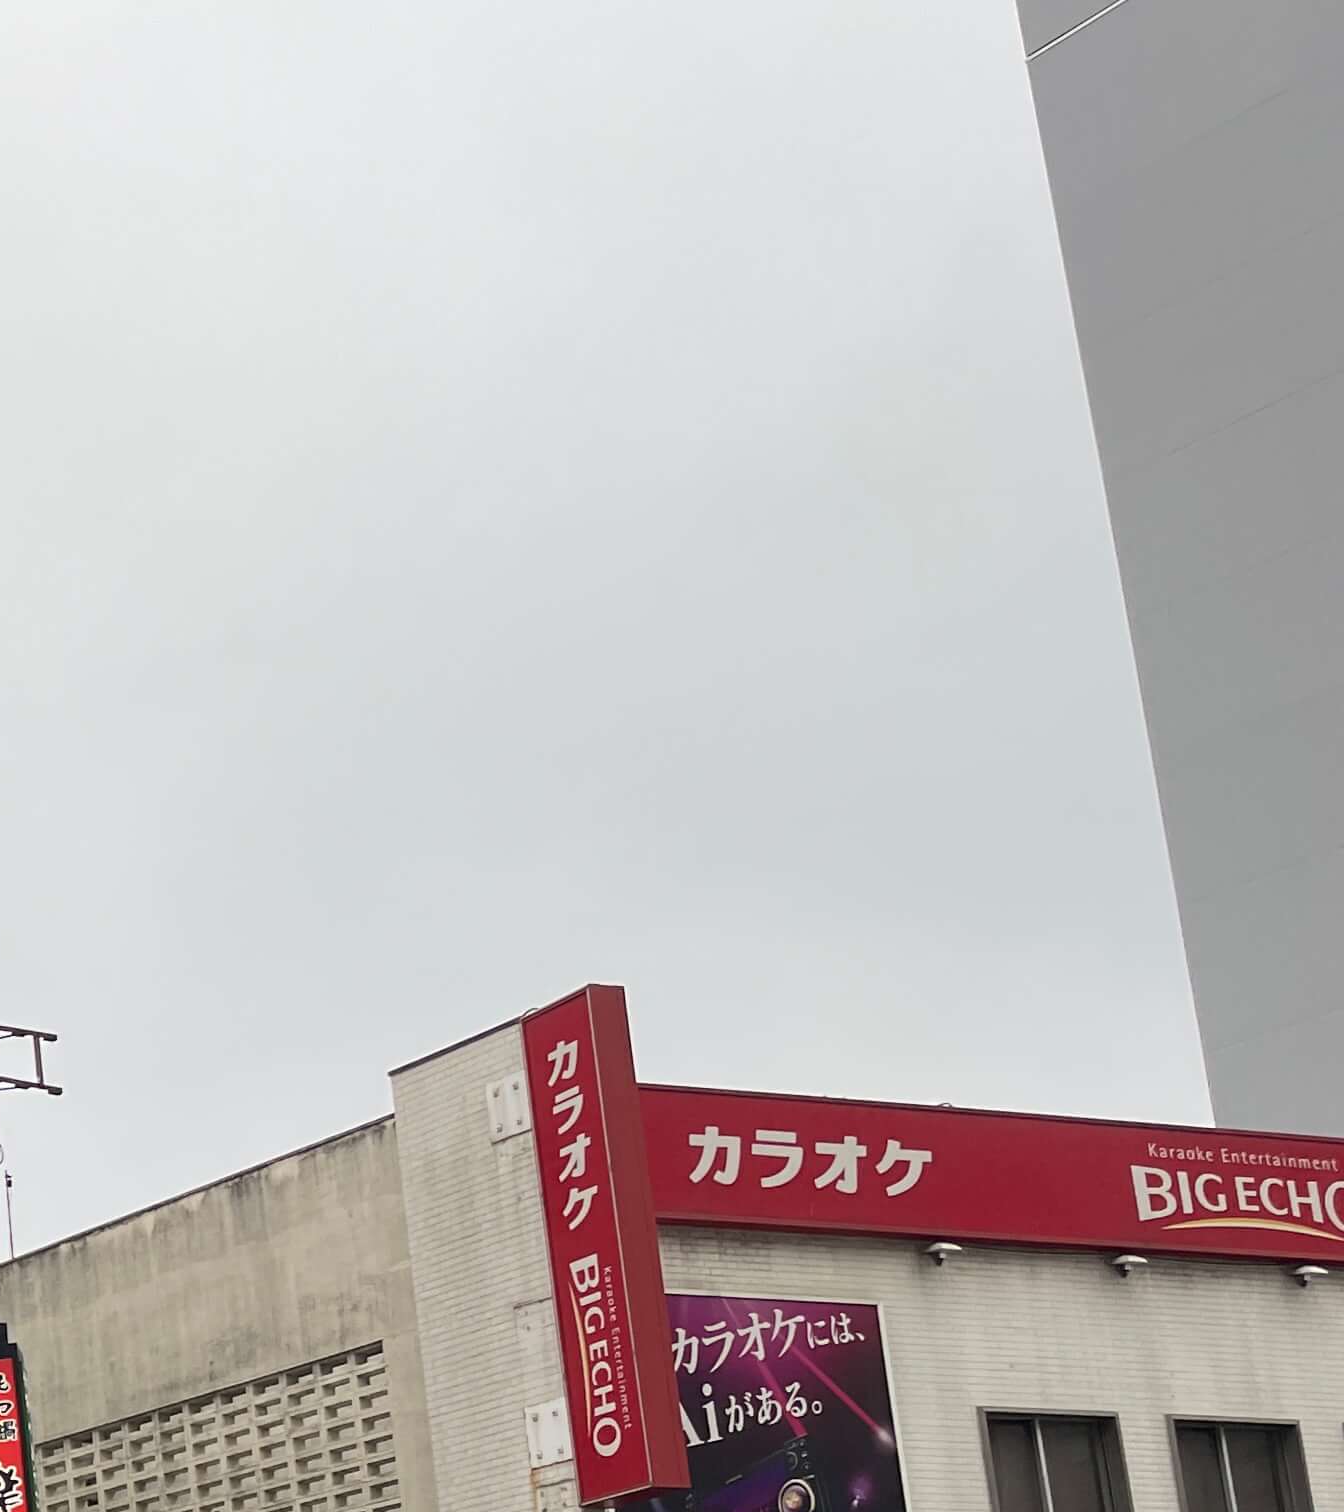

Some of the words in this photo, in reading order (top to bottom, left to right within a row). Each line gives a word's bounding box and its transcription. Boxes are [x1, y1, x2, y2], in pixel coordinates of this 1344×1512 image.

[547, 1040, 599, 1231] カラオケ
[688, 1126, 933, 1197] カラオケ
[1146, 1142, 1214, 1163] Karaoke
[1220, 1147, 1339, 1172] Entertainment
[1130, 1164, 1228, 1222] BIG
[568, 1253, 605, 1335] BIG
[603, 1265, 618, 1322] Karaoke
[611, 1326, 632, 1432] Entertainment
[671, 1308, 866, 1375] カラオケには、
[586, 1339, 622, 1458] ECHO
